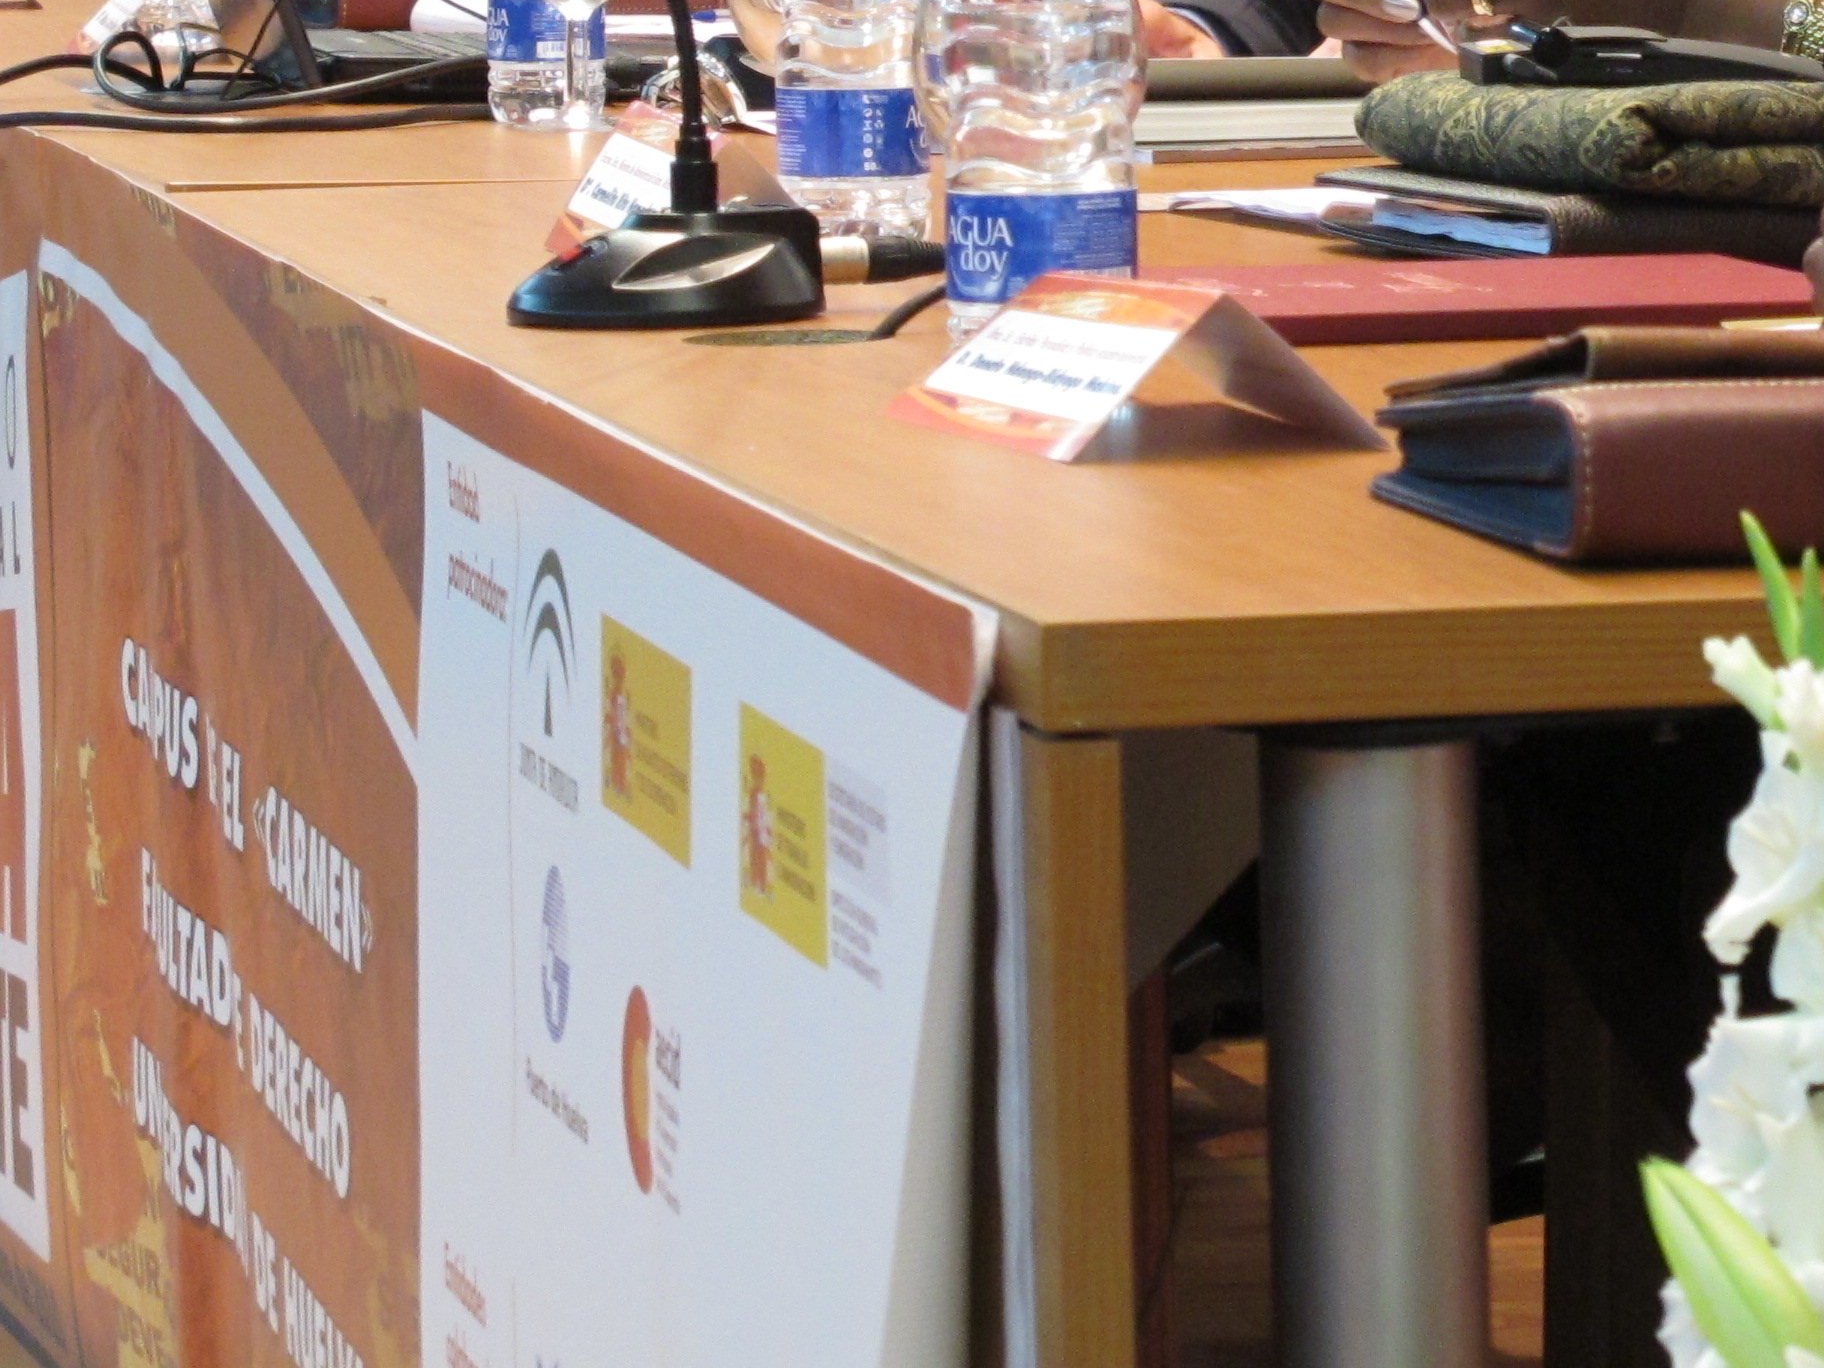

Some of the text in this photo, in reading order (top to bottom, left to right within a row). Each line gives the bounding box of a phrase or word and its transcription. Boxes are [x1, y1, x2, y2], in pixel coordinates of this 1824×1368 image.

[949, 215, 1014, 248] AGUA
[960, 237, 1008, 281] doy
[121, 636, 200, 790] CAPUS
[248, 991, 350, 1200] DERECHO
